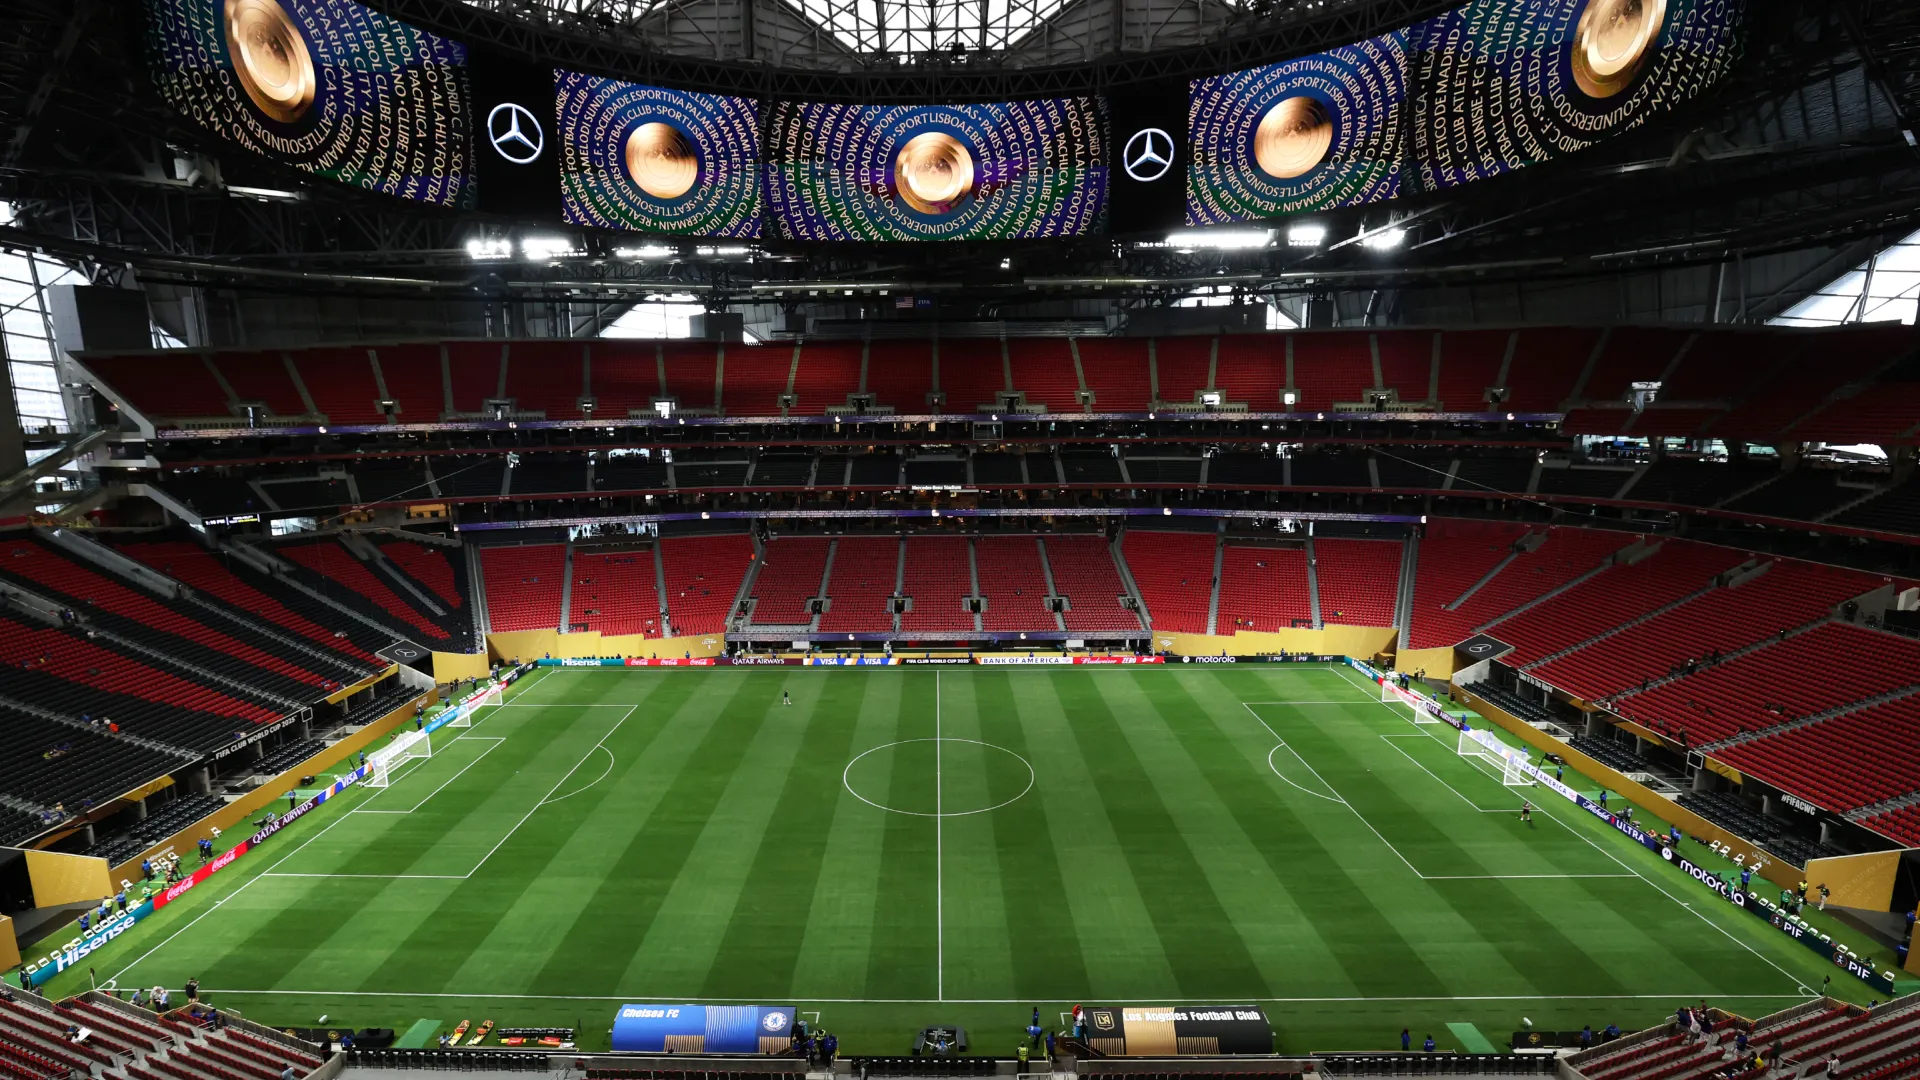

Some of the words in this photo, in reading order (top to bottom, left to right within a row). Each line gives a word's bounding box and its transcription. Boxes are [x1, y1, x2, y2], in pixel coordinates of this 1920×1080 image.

[316, 6, 344, 56] PARIS
[1476, 2, 1506, 64] BAYERN
[1494, 21, 1515, 65] CLUB
[304, 17, 337, 91] BENFICA
[1420, 33, 1441, 80] ULSAN
[1436, 29, 1460, 94] MADRID
[1529, 22, 1550, 117] SOCIEDADE
[354, 56, 372, 99] CITY
[378, 34, 406, 97] MILANO
[397, 108, 409, 152] CLUBE
[438, 57, 460, 114] MADRID
[1260, 82, 1286, 104] CLUB
[1292, 77, 1327, 89] SPORT
[1378, 60, 1397, 97] MIAMI
[1490, 76, 1502, 116] CLUB
[1547, 45, 1576, 123] FOOTBALL
[376, 74, 392, 124] CLUBE
[408, 70, 427, 137] PACHUCA
[570, 89, 588, 115] CLUB
[627, 105, 652, 120] CLUB
[656, 105, 689, 124] SPORT
[1224, 80, 1265, 137] SOCIEDADE
[1265, 60, 1323, 84] ESPORTIVA
[1324, 62, 1366, 109] PALMEIRAS
[1324, 82, 1350, 116] LISBOA
[1358, 64, 1382, 146] MANCHESTER
[594, 94, 631, 141] SOCIEDADE
[630, 90, 684, 107] ESPORTIVA
[686, 102, 724, 154] PALMEIRAS
[608, 116, 630, 166] FOOTBALL
[686, 120, 711, 155] LISBOA
[732, 119, 751, 151] MIAMI
[770, 114, 785, 149] ULSAN
[817, 113, 836, 155] BAYERN
[980, 119, 1002, 149] PARIS
[1033, 114, 1053, 159] MILANO
[1084, 112, 1100, 156] MADRID
[1194, 120, 1208, 174] FOOTBALL
[1203, 91, 1221, 118] CLUB
[1236, 104, 1262, 159] FOOTBALL
[1354, 115, 1367, 147] PARIS
[1380, 103, 1398, 157] FUTEBOL
[1416, 92, 1428, 149] BENFICA
[1454, 117, 1468, 152] CLUB
[1471, 96, 1488, 153] TUNISIE
[342, 108, 374, 182] JUVENTUS
[565, 116, 578, 170] FOOTBALL
[580, 122, 597, 187] MAMELODI
[715, 116, 741, 189] MANCHESTER
[785, 118, 800, 165] MADRID
[831, 132, 846, 160] CLUB
[878, 136, 895, 165] CLUB
[895, 113, 928, 136] SPORT
[930, 113, 965, 131] LISBOA
[970, 130, 992, 178] BENFICA
[1010, 142, 1023, 170] CITY
[1056, 132, 1068, 187] PACHUCA
[1208, 123, 1222, 185] MAMELODI
[1326, 122, 1352, 170] BENFICA
[695, 162, 714, 201] BENFICA
[718, 160, 728, 187] PARIS
[742, 159, 754, 200] FUTEBOL
[769, 159, 781, 202] BENFICA
[830, 168, 841, 197] CLUB
[860, 144, 877, 208] SOCIEDADE
[1027, 148, 1038, 184] CLUBE
[1225, 165, 1252, 201] MADRID
[1238, 160, 1280, 197] SOUNDERS
[1284, 149, 1360, 212] SAINT-GERMAIN
[1357, 148, 1375, 178] CITY
[1360, 160, 1386, 195] CLUBE
[598, 169, 628, 211] MADRID
[610, 167, 654, 212] SOUNDERS
[722, 190, 738, 214] CITY
[802, 188, 816, 216] CLUB
[816, 178, 832, 220] TUNISIE
[876, 166, 904, 221] FOOTBALL
[960, 183, 990, 225] SEATTLE
[970, 149, 1007, 236] SAINT-GERMAIN
[1040, 167, 1053, 201] CLUBE
[1220, 190, 1241, 212] CLUB
[1252, 196, 1276, 211] REAL
[1280, 172, 1326, 197] SEATTLE
[596, 194, 618, 220] CLUB
[628, 208, 652, 226] REAL
[654, 200, 696, 216] SEATTLE
[660, 187, 724, 230] SAINT-GERMAIN
[727, 202, 747, 230] CLUBE
[902, 216, 960, 234] SOUNDERS
[990, 180, 1022, 238] JUVENTUS
[1352, 659, 1373, 679] Hisense
[1440, 712, 1460, 728] AIRWAYS
[216, 748, 230, 760] FIFA
[231, 740, 247, 752] CLUB
[247, 729, 269, 744] WORLD
[270, 724, 281, 734] CUP
[341, 771, 358, 787] VISA
[1539, 773, 1567, 794] AMERICA
[252, 822, 280, 844] QATAR
[282, 801, 313, 826] AIRWAYS
[1582, 800, 1609, 820] Michelob
[1616, 819, 1645, 844] ULTRA
[1781, 794, 1816, 816] #FIFACWC
[212, 848, 236, 872] Coca-Cola
[167, 876, 194, 900] Coca-Cola
[57, 916, 135, 972] Hisense
[1784, 923, 1802, 938] PIF
[1848, 962, 1870, 980] PIF
[622, 1008, 664, 1018] Chelsea
[666, 1009, 680, 1018] FC
[1123, 1012, 1142, 1020] Los
[1144, 1012, 1187, 1022] Angeles
[1191, 1012, 1233, 1021] Football
[1237, 1012, 1261, 1020] Club
